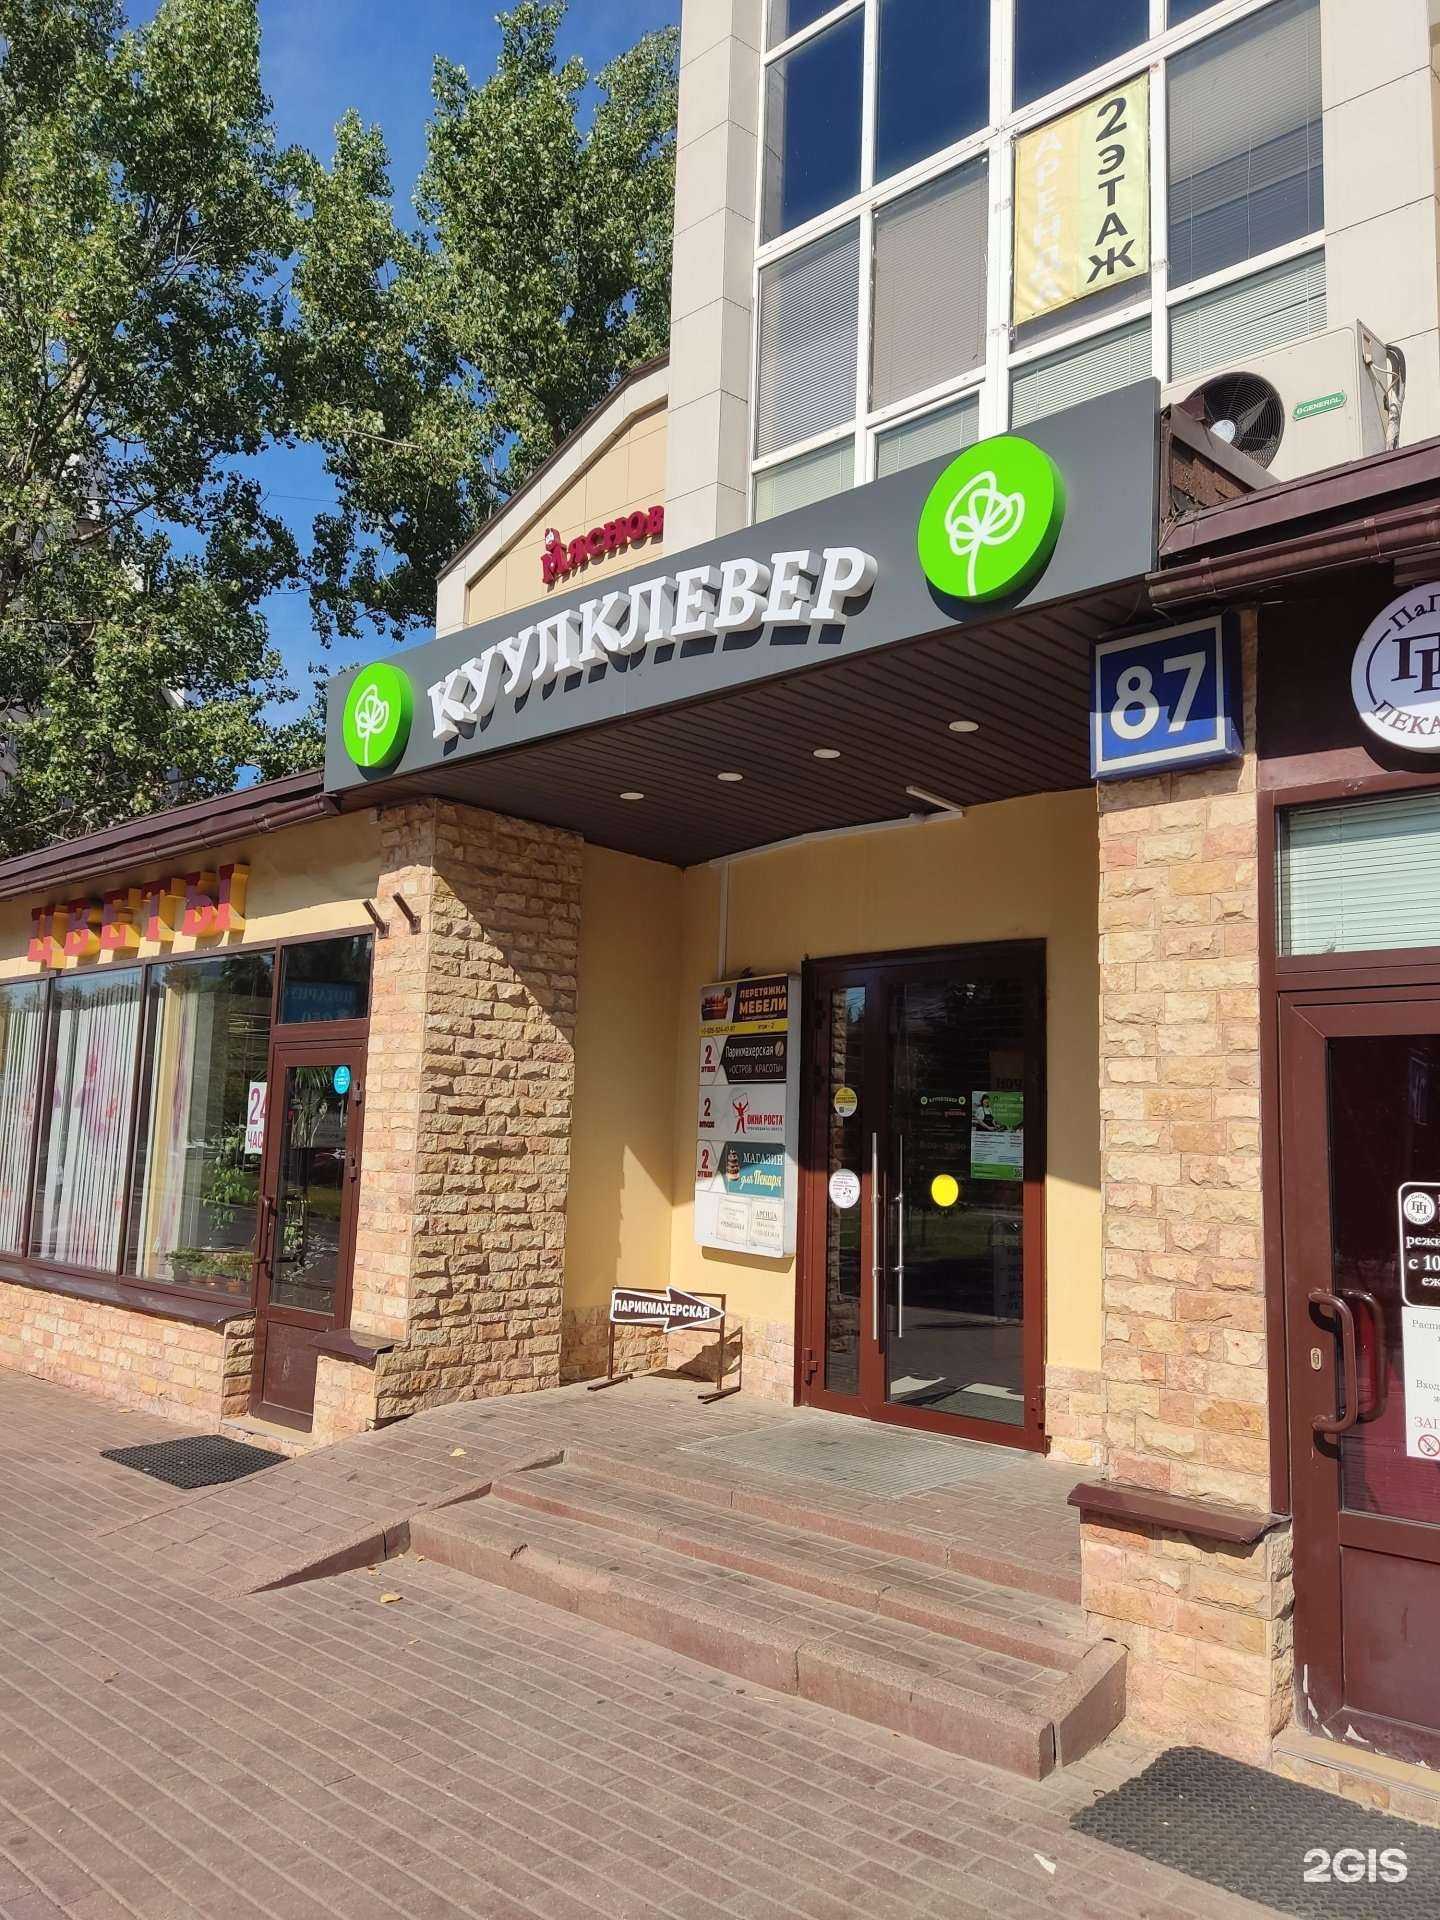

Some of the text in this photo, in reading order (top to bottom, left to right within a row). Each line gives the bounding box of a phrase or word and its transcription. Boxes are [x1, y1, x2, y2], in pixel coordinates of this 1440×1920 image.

[1087, 97, 1136, 284] 2 ЭТАЖ
[1030, 131, 1063, 308] АРЕНДА
[427, 546, 878, 741] КУУЛКЛЕВЕР
[1110, 651, 1206, 740] 87
[28, 863, 249, 969] ЦВЕТЫ
[739, 997, 787, 1015] МЕБЕЛИ
[704, 1045, 713, 1065] 2
[725, 1045, 775, 1059] Парикмахерская
[703, 1097, 712, 1117] 2
[746, 1114, 783, 1126] ОКНА РОСТА
[701, 1148, 710, 1169] 2
[742, 1152, 784, 1166] МАГАЗИН
[753, 1169, 782, 1191] Пекаря
[614, 1299, 710, 1319] ПАРИКМАХЕРСКАЯ
